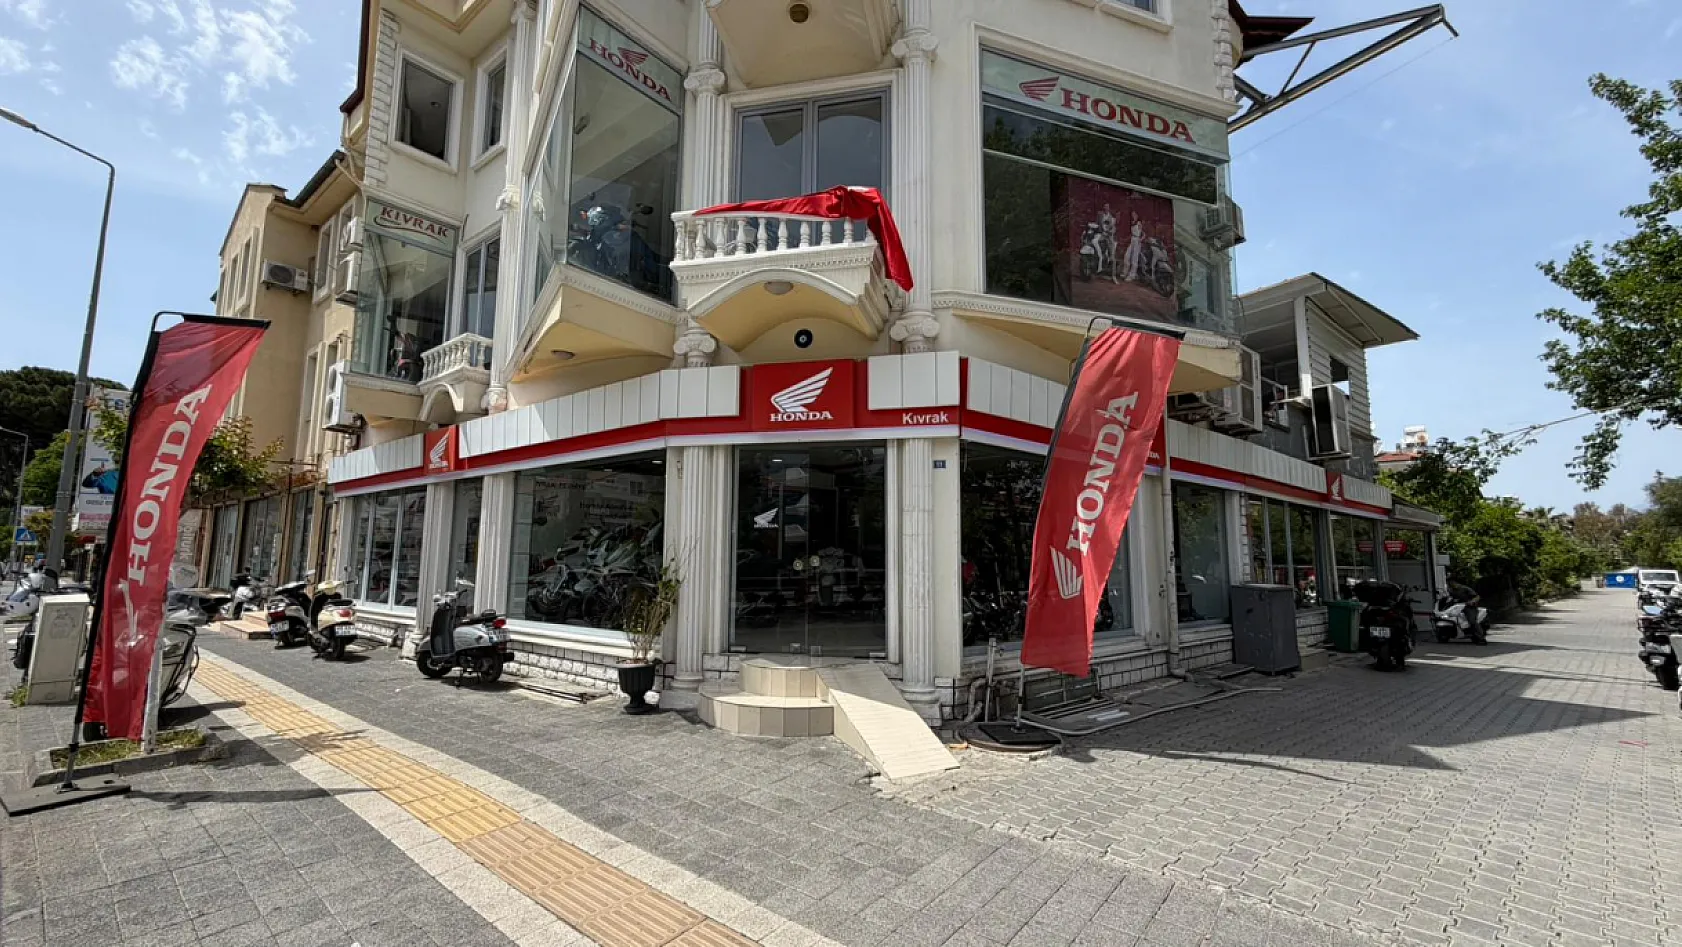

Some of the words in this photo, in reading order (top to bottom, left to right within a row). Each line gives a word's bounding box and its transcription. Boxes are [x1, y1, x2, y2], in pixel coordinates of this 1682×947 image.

[589, 37, 672, 101] HONDA
[1060, 87, 1196, 145] HONDA
[381, 206, 449, 238] KIVRAK
[769, 410, 834, 422] HONDA
[902, 410, 950, 425] Kıvrak
[128, 383, 212, 587] HONDA
[1066, 391, 1139, 557] HONDA
